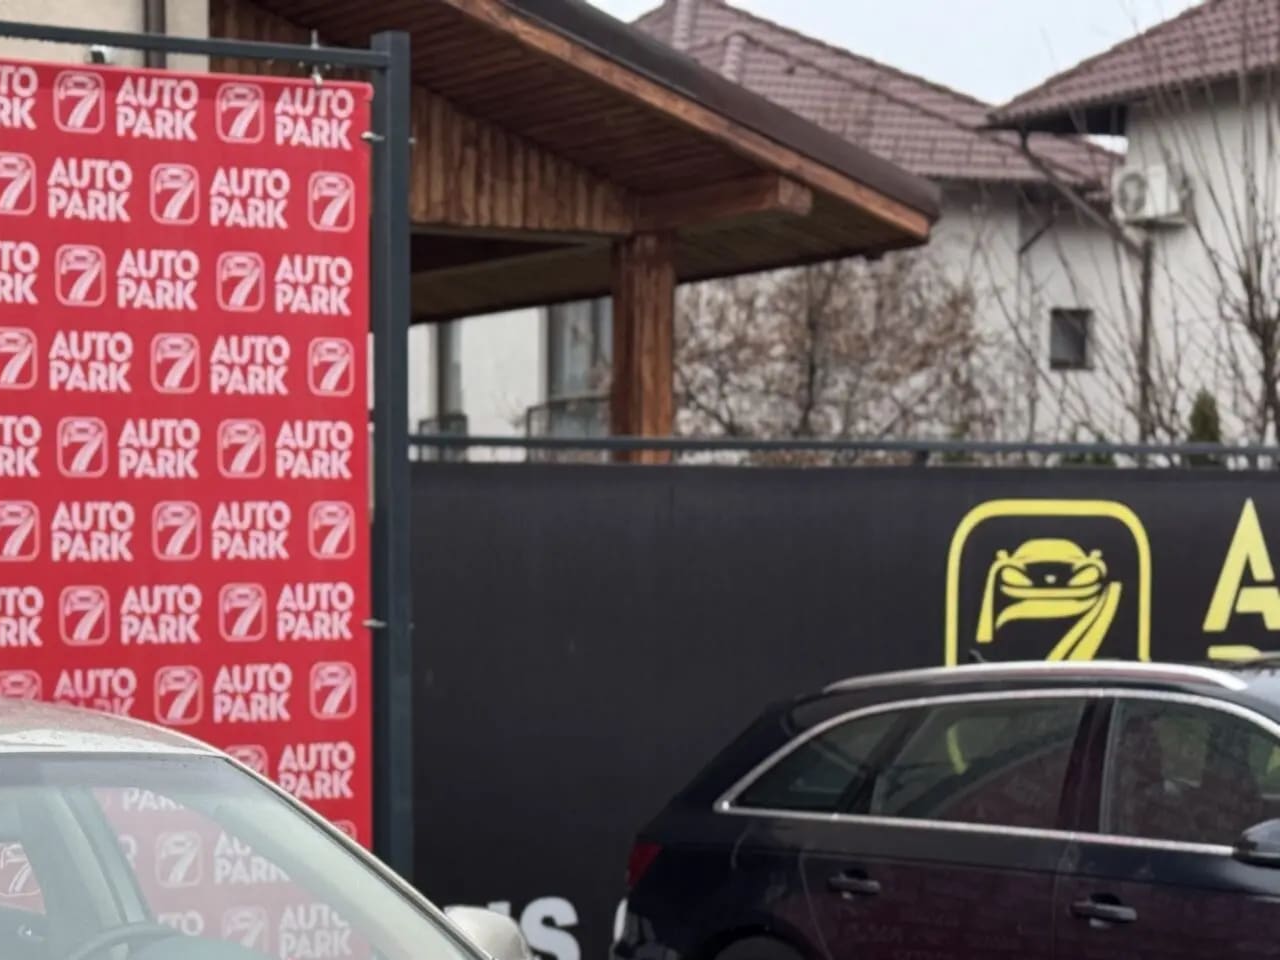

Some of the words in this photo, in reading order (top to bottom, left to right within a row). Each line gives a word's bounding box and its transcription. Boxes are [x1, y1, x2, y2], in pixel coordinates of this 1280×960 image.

[116, 77, 198, 111] AUTO
[275, 90, 354, 118] AUTO
[117, 105, 197, 141] PARK
[276, 114, 352, 150] PARK
[48, 158, 132, 191] AUTO
[210, 168, 290, 199] AUTO
[48, 186, 130, 222] PARK
[210, 195, 288, 229] PARK
[117, 249, 199, 280] AUTO
[275, 255, 353, 286] AUTO
[118, 278, 197, 310] PARK
[275, 283, 351, 316] PARK
[49, 331, 133, 363] AUTO
[211, 336, 290, 365] AUTO
[50, 360, 131, 393] PARK
[211, 364, 288, 395] PARK
[119, 419, 200, 448] AUTO
[276, 420, 353, 450] AUTO
[119, 447, 198, 478] PARK
[276, 449, 352, 479] PARK
[52, 501, 135, 531] AUTO
[212, 501, 291, 531] AUTO
[52, 530, 133, 562] PARK
[212, 530, 289, 560] PARK
[121, 584, 202, 615] AUTO
[277, 582, 354, 612] AUTO
[121, 613, 200, 644] PARK
[277, 609, 352, 640] PARK
[54, 667, 137, 698] AUTO
[214, 663, 292, 694] AUTO
[214, 691, 290, 722] PARK
[279, 741, 355, 771] AUTO
[279, 770, 354, 802] PARK
[280, 928, 352, 960] PARK
